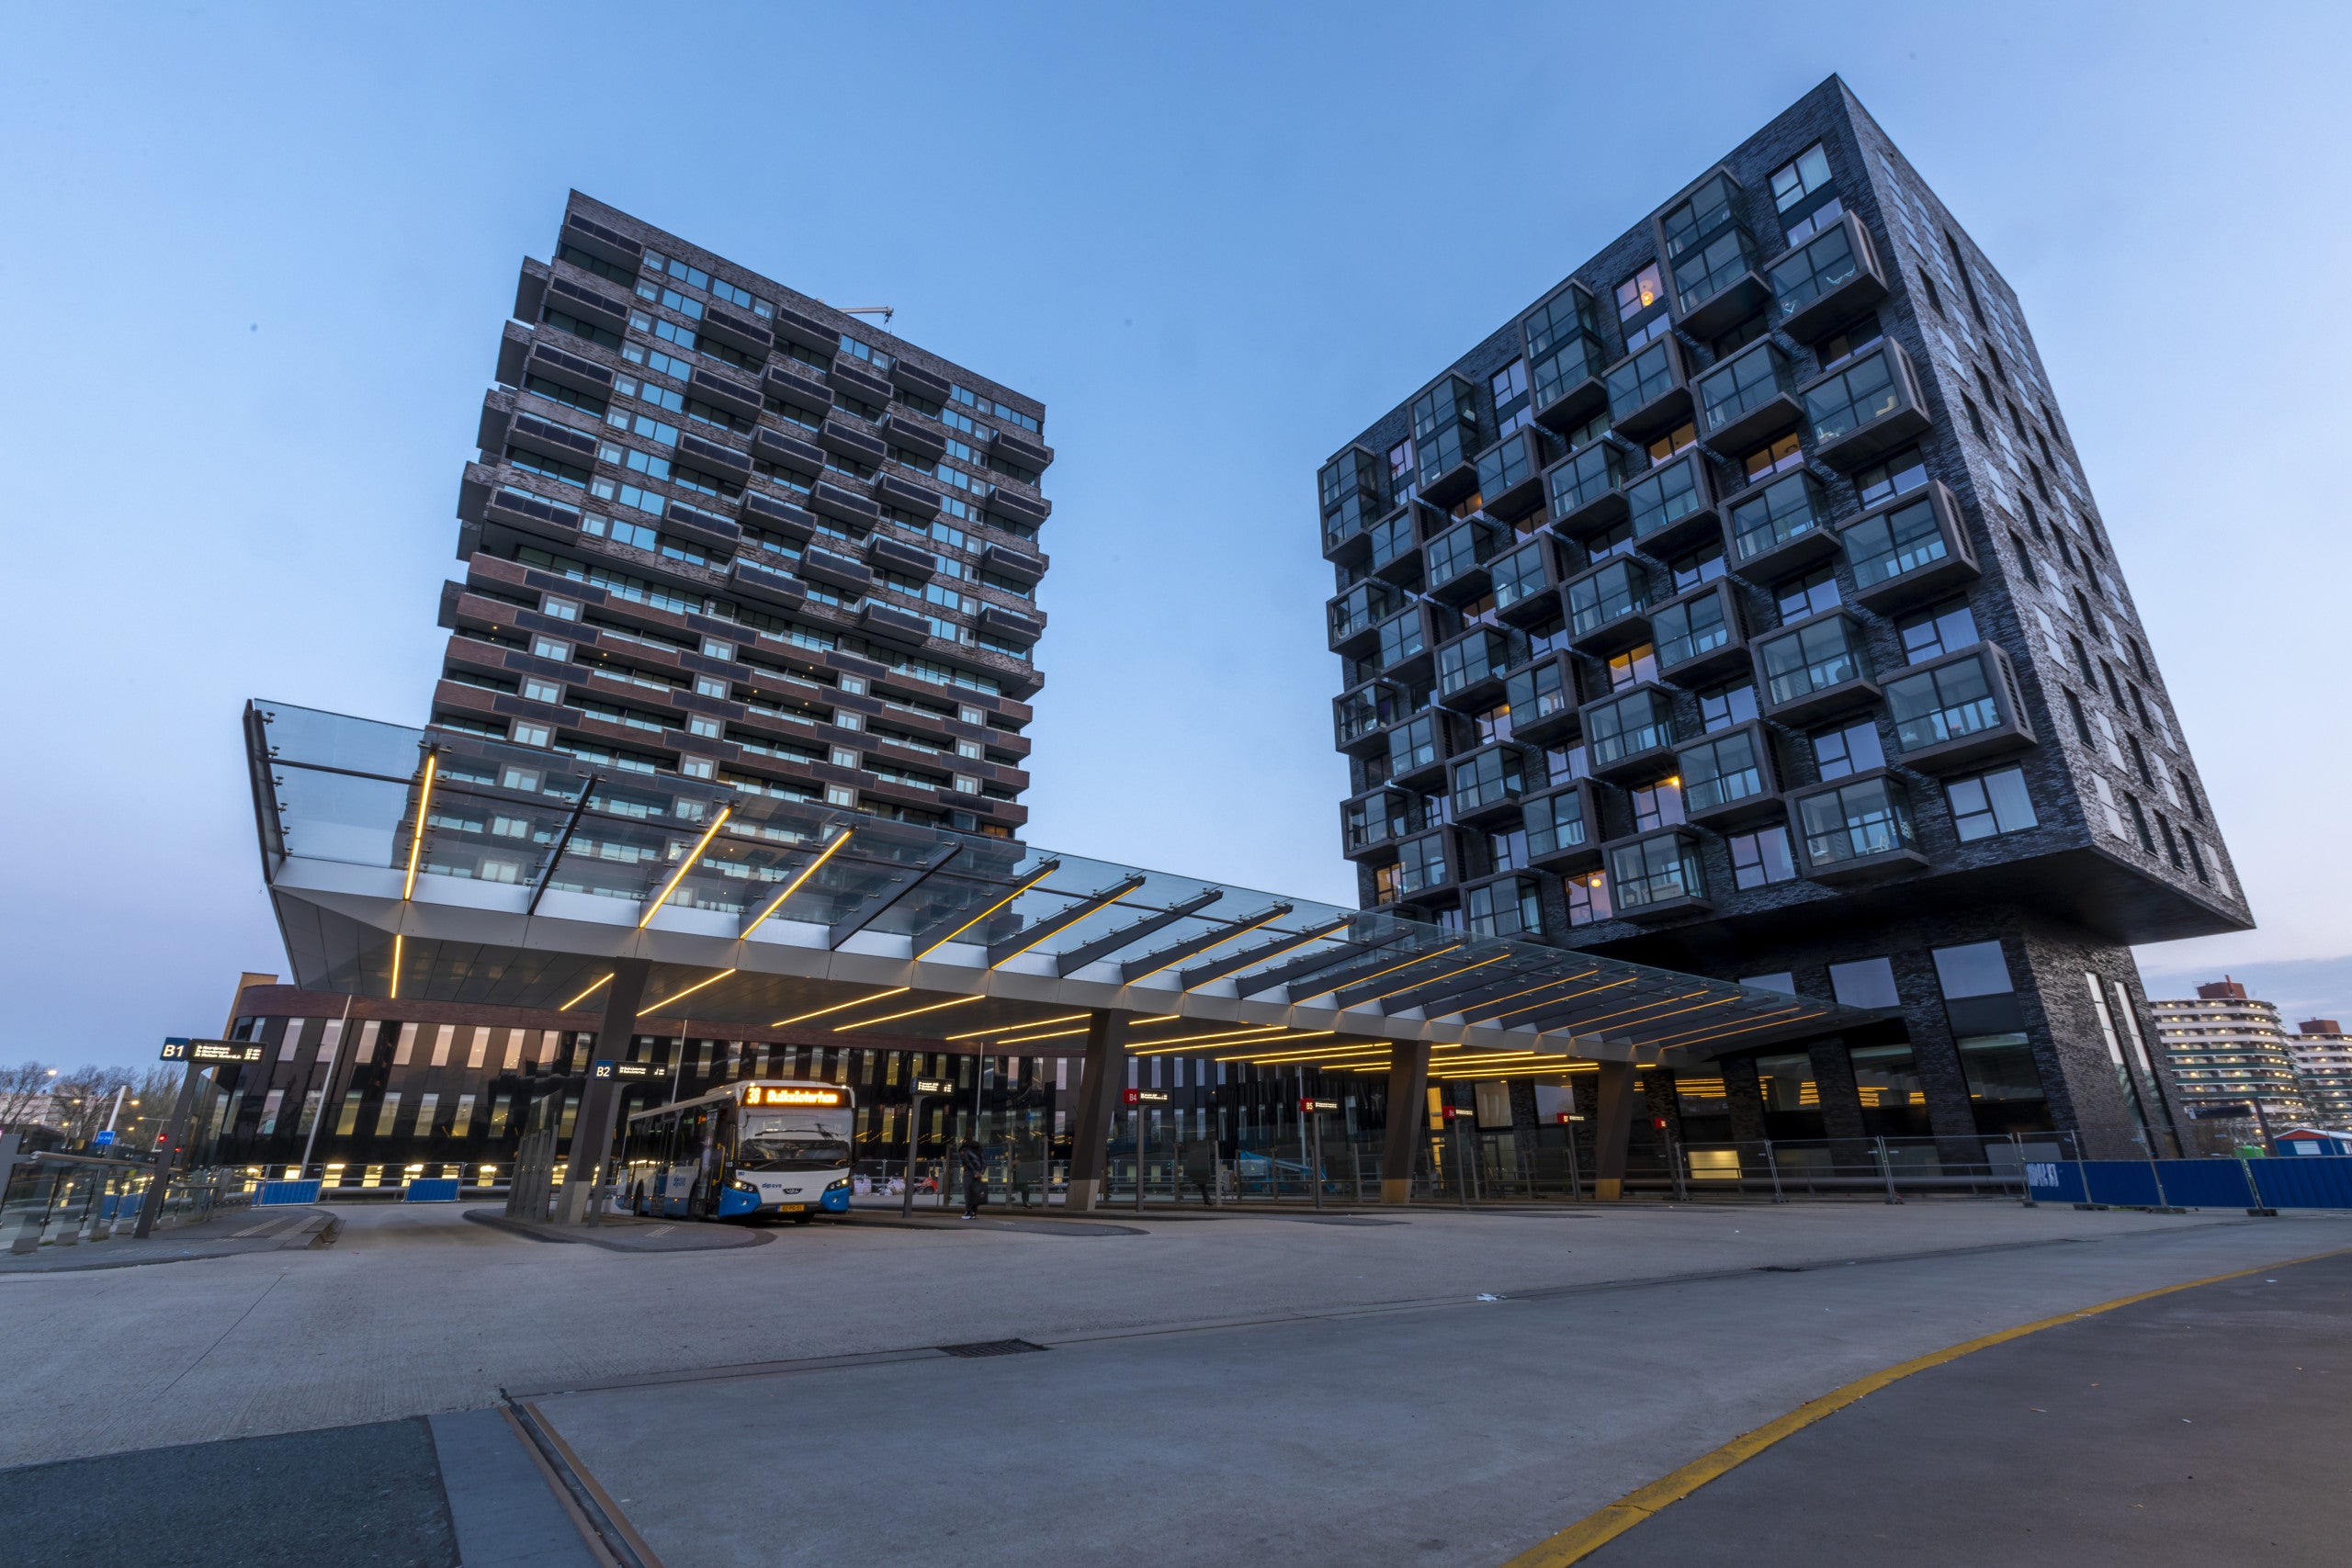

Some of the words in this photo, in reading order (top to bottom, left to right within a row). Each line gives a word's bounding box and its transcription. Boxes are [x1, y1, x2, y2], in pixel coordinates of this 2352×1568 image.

[163, 1044, 184, 1057] B1
[596, 1066, 610, 1077] B2
[747, 1087, 761, 1104] 38
[767, 1089, 837, 1103] Buiksloterham
